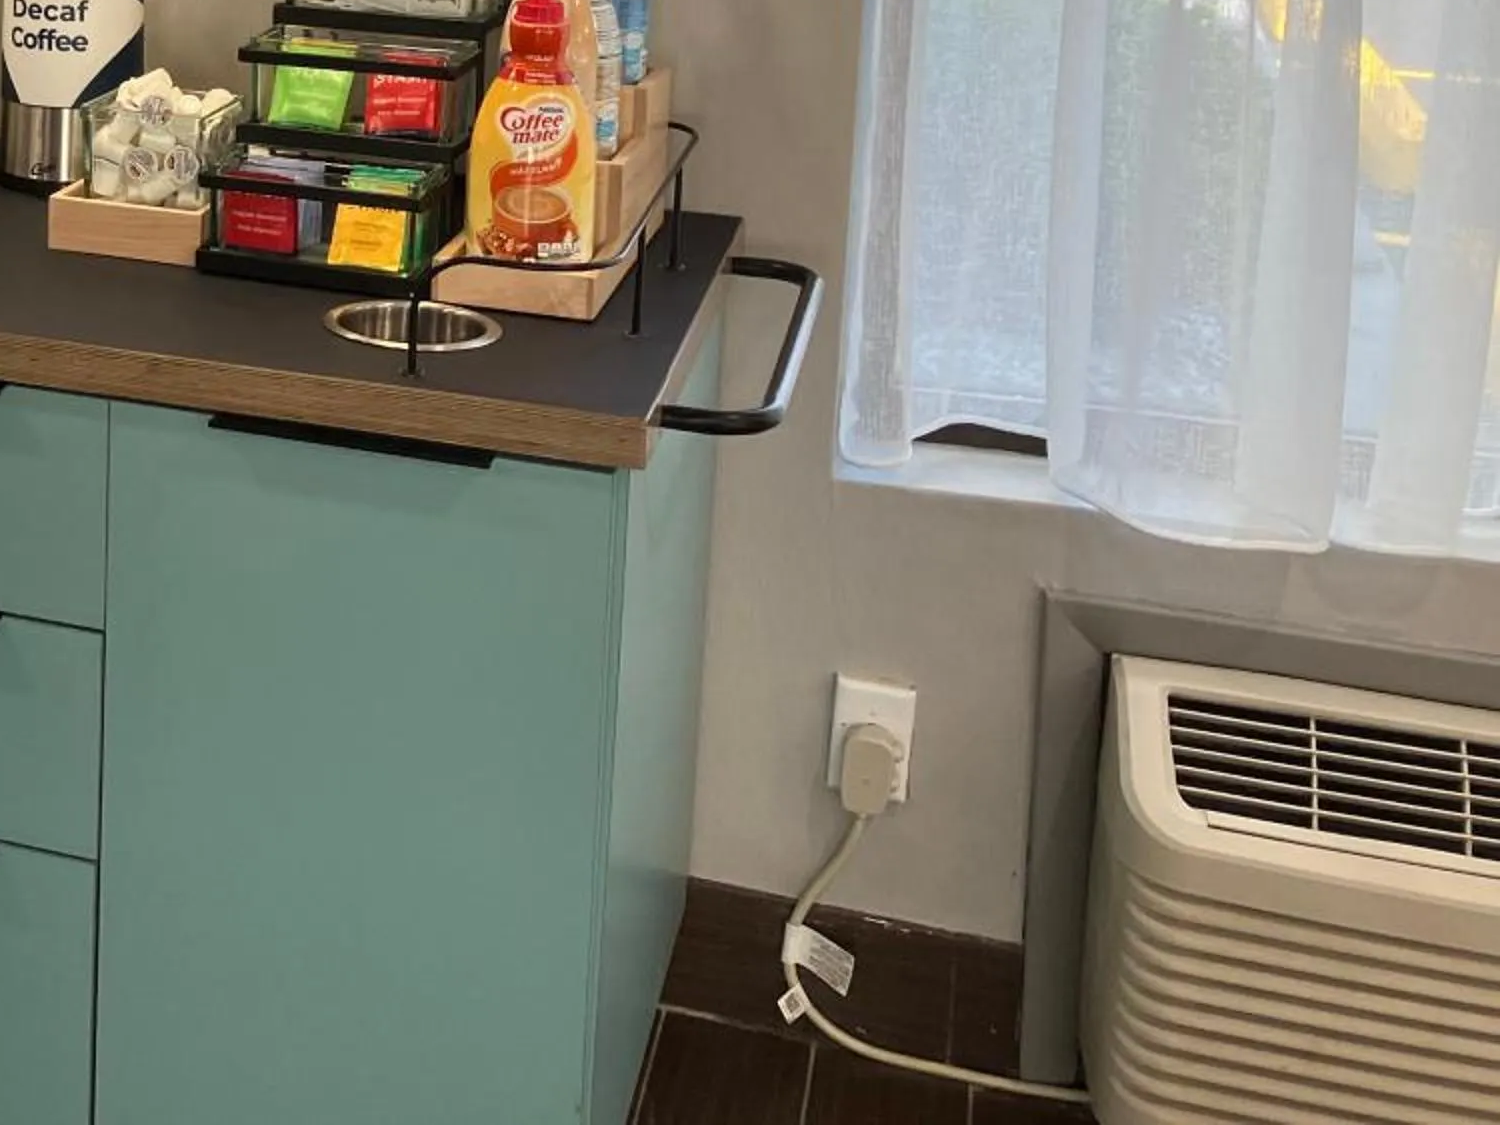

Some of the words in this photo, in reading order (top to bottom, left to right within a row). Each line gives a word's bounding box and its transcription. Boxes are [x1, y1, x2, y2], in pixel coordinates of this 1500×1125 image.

[11, 26, 89, 52] Coffee
[500, 107, 564, 131] Coffee
[512, 130, 560, 144] mate
